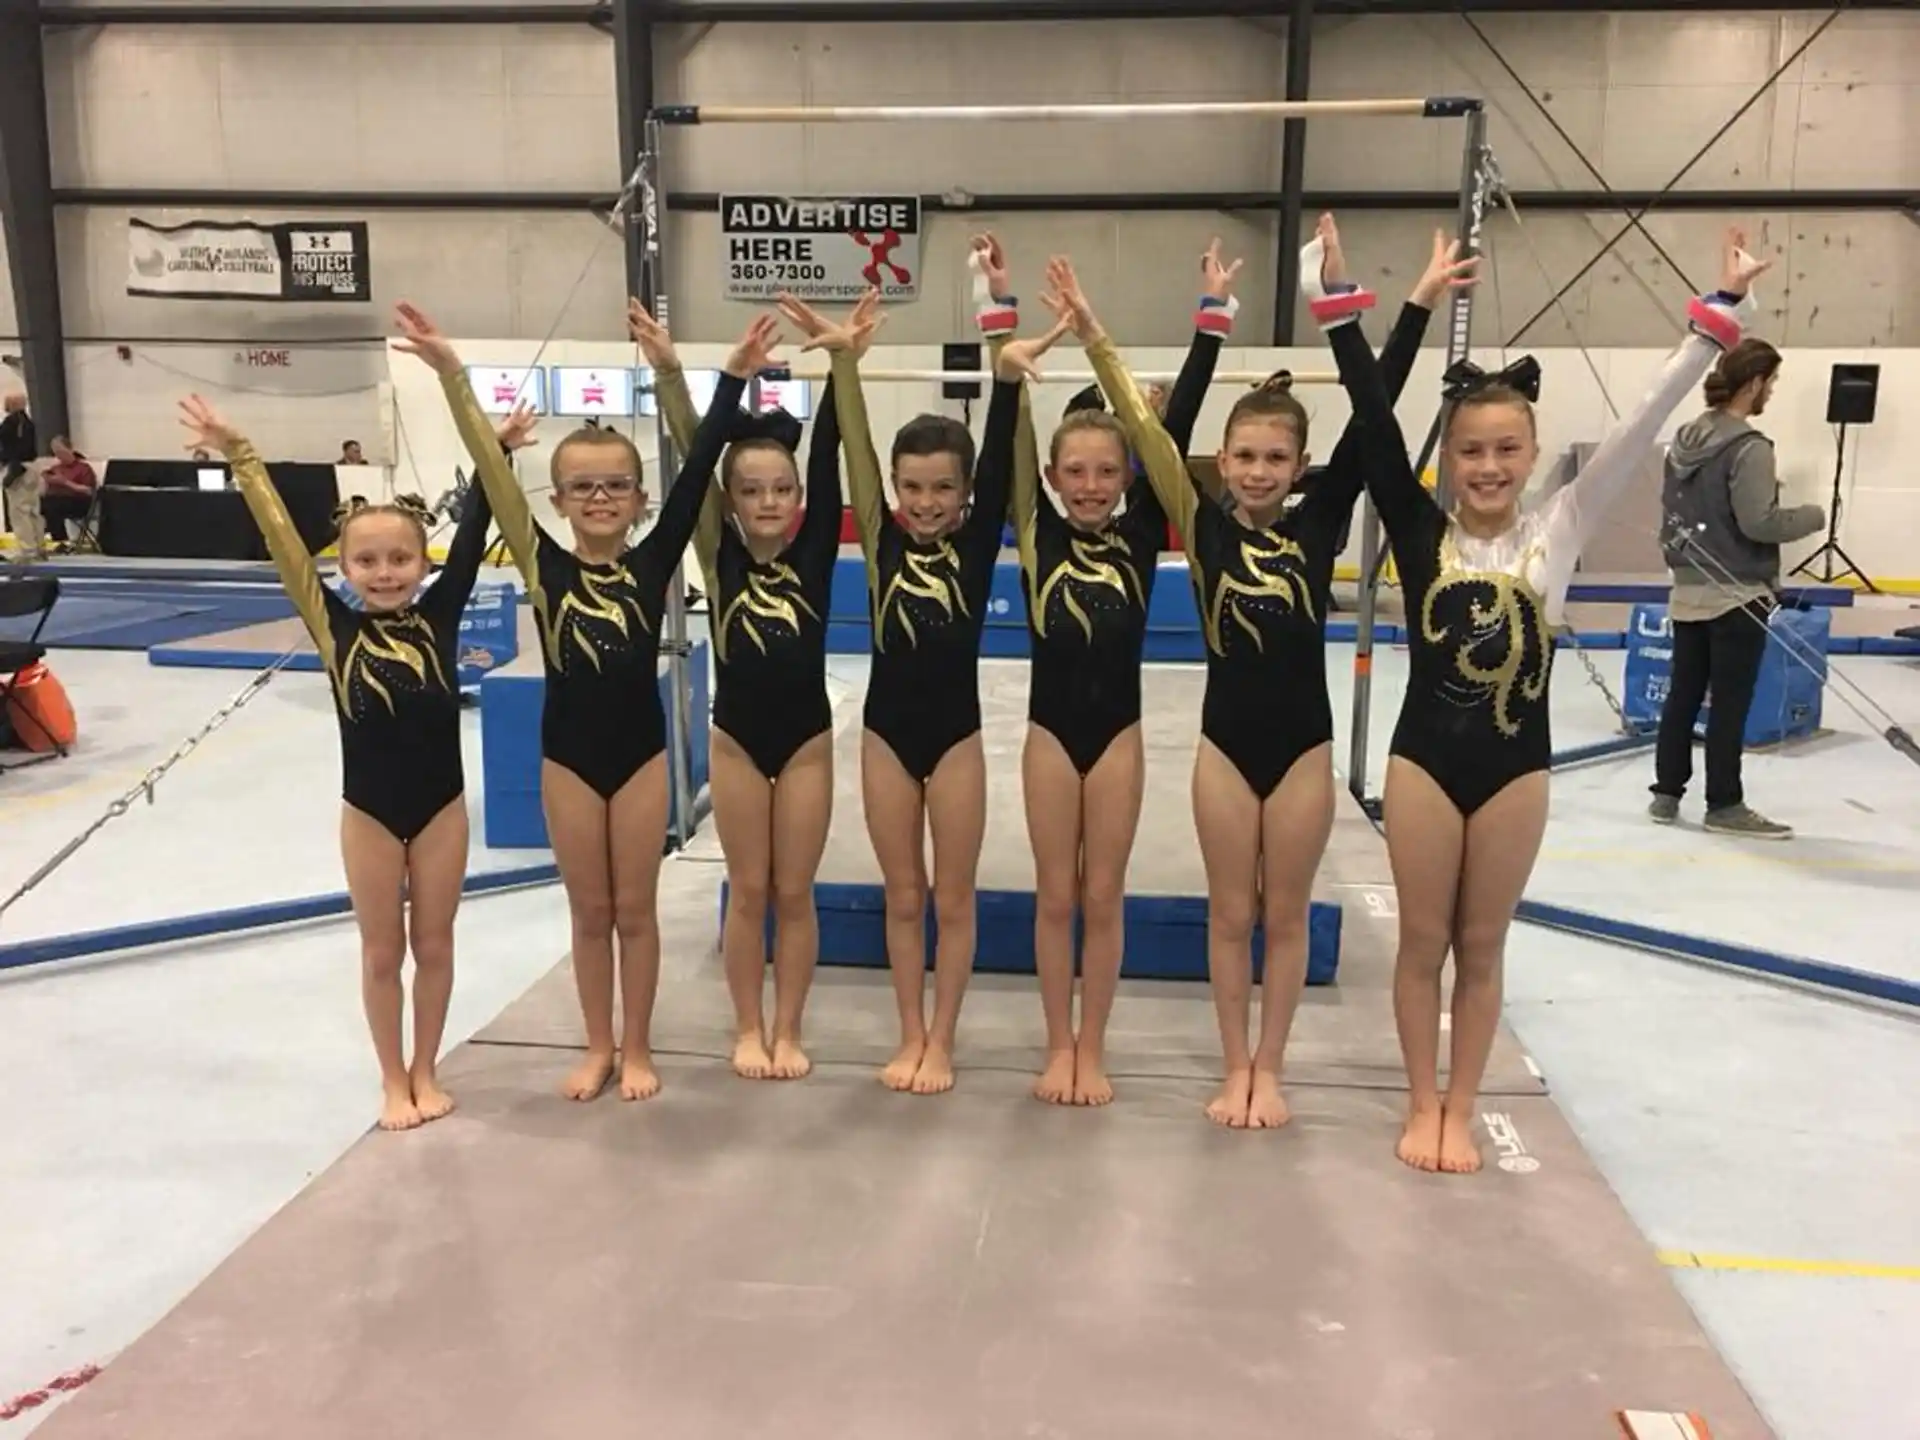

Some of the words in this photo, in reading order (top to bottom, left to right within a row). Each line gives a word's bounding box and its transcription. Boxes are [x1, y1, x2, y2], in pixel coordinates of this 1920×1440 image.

[730, 203, 907, 228] ADVERTISE
[731, 239, 812, 261] HERE
[292, 254, 355, 272] PROTECT
[248, 350, 291, 367] HOME
